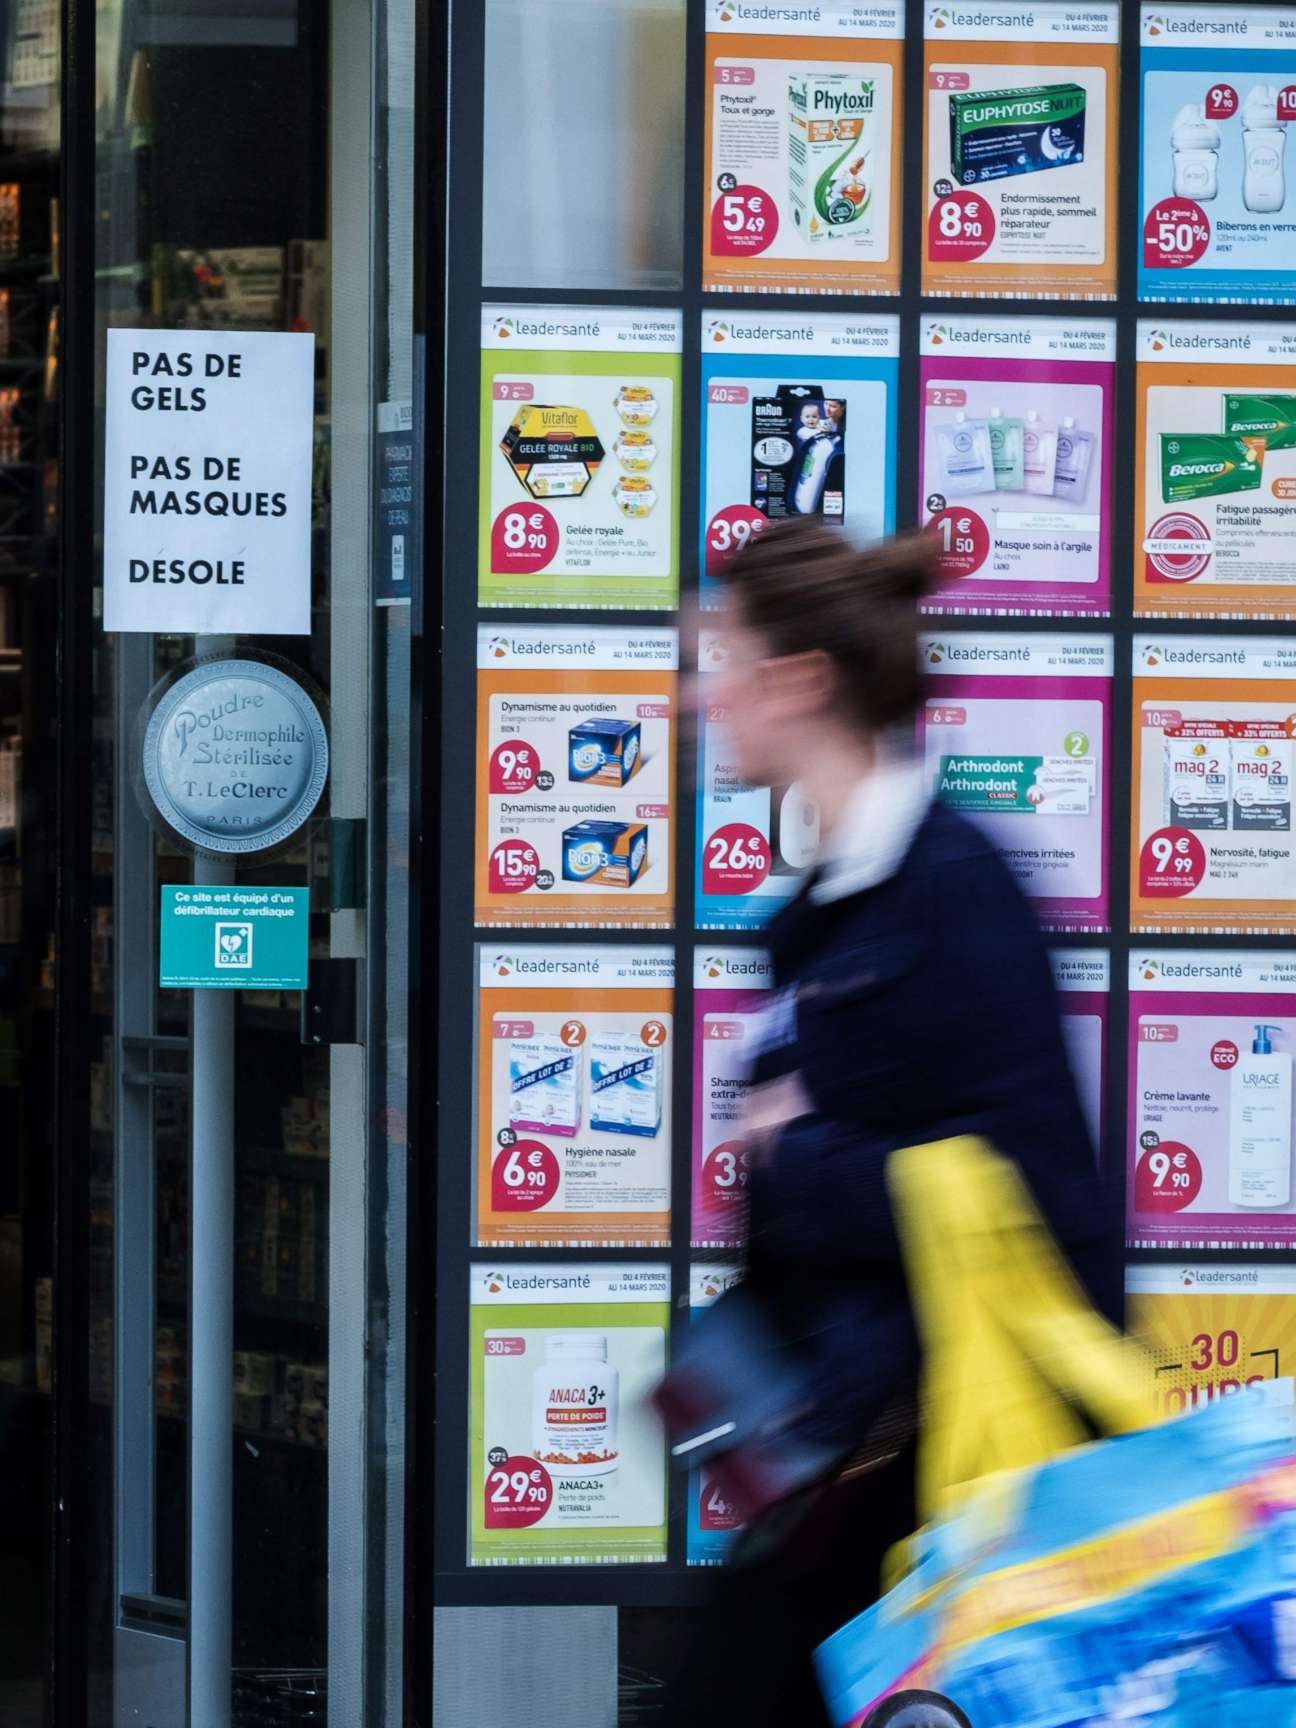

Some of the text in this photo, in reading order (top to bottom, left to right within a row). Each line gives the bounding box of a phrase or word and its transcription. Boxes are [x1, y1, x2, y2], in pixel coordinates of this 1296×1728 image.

[814, 89, 874, 110] Phytoxil
[1001, 193, 1080, 204] Endormissement
[1001, 206, 1021, 217] plus
[1056, 207, 1097, 217] sommeil
[1000, 219, 1050, 231] réparateur
[1217, 222, 1257, 231] Biberons
[133, 352, 241, 377] PAS DE
[131, 386, 206, 411] GELS
[542, 412, 578, 426] Vitaflor
[1231, 422, 1277, 432] Berocca
[131, 456, 240, 481] PAS DE
[1169, 463, 1225, 477] Berocca
[130, 490, 287, 517] MASQUES
[1216, 504, 1296, 517] Fatigue passagèr
[1216, 516, 1262, 526] irritabilité
[566, 526, 624, 537] Gelée royale
[129, 546, 247, 584] DÉSOLÉ
[500, 702, 617, 716] Dynamisme au quotidien
[174, 693, 264, 758] Poudre
[213, 724, 305, 747] Dermophile
[192, 742, 293, 765] Stérilisée
[947, 759, 1024, 773] Arthrodont
[1175, 760, 1219, 777] mag 2
[1237, 761, 1281, 778] mag 2
[941, 778, 1017, 791] Arthrodont
[500, 803, 616, 816] Dynamisme au quotidien
[206, 815, 264, 825] PARIS
[1210, 847, 1290, 860] Nervosité, fatigue
[175, 892, 294, 904] Ce site est équipé d'un
[174, 906, 294, 918] défibrillateur cardiaque
[221, 954, 247, 963] DAE
[1213, 1054, 1236, 1064] ECO
[711, 1077, 753, 1090] Shamp
[1144, 1090, 1211, 1102] Crème lavante
[565, 1147, 637, 1158] Hygiène nasale
[1190, 1329, 1239, 1371] 30
[548, 1387, 585, 1403] ANACA
